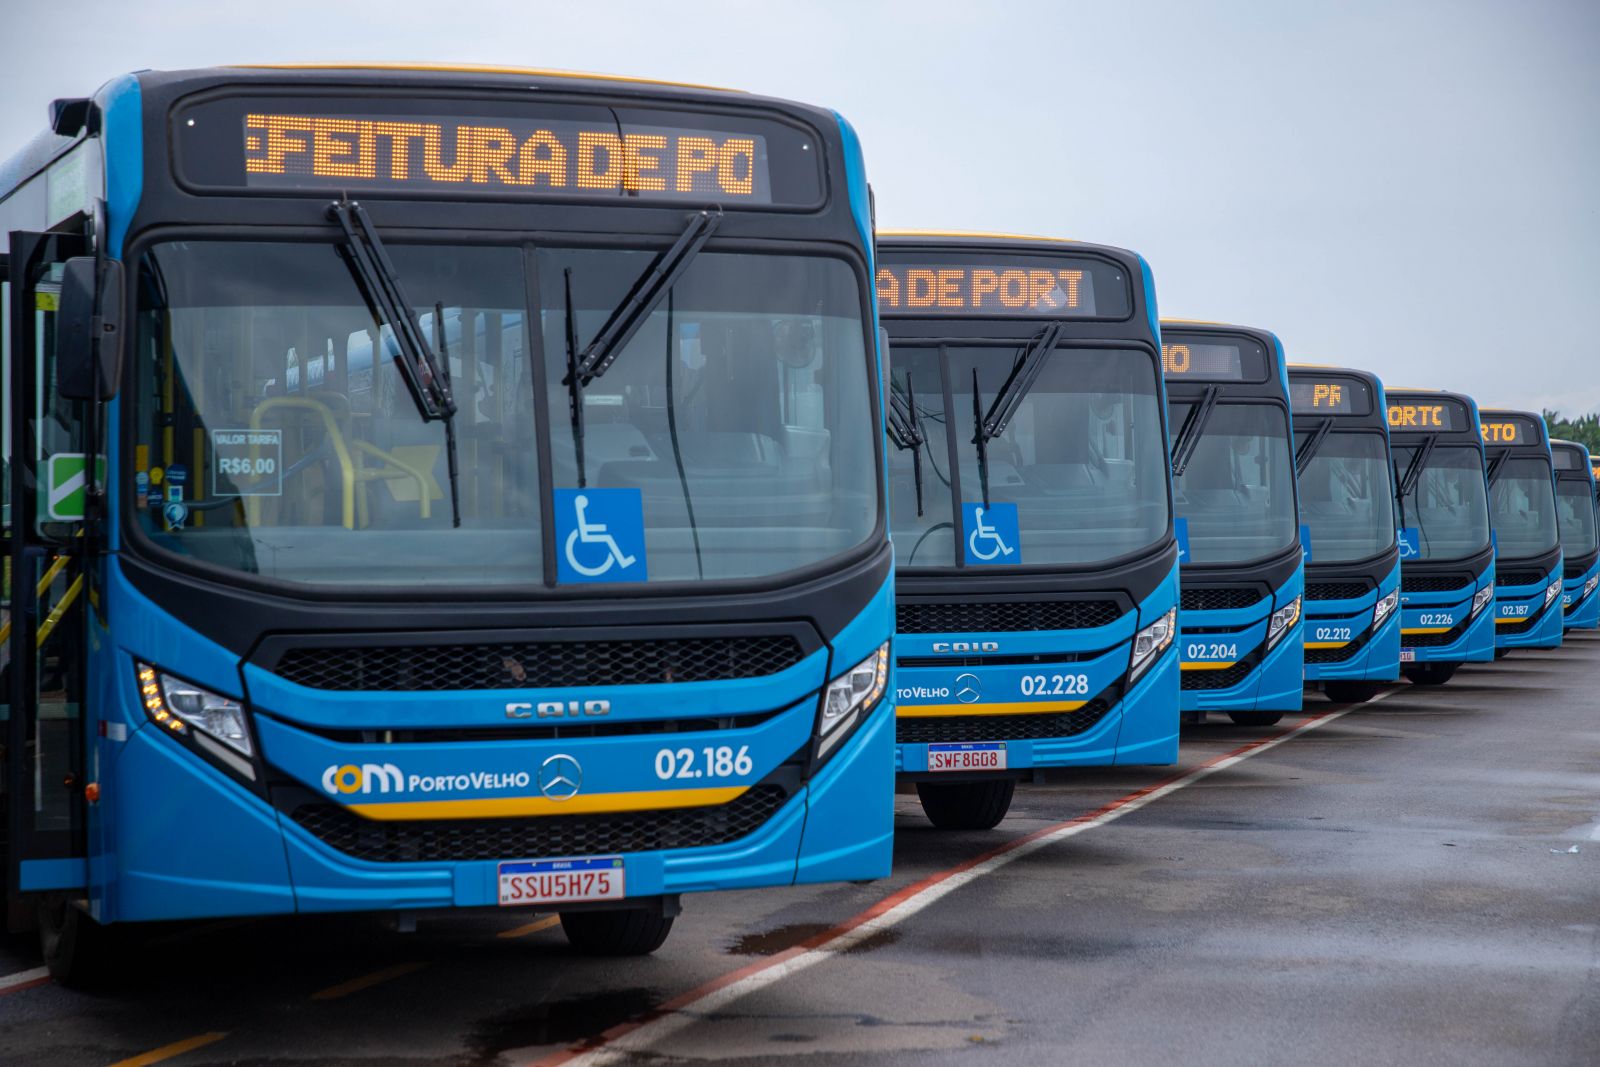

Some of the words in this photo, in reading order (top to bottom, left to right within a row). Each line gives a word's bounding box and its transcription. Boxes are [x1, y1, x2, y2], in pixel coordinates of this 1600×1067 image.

[577, 131, 667, 191] DE
[907, 269, 964, 307] DE
[971, 269, 1082, 307] PORT
[219, 458, 275, 477] R$6,00
[1420, 614, 1453, 625] 02.226
[1502, 606, 1528, 615] 02.187
[1316, 628, 1351, 640] 02.212
[1187, 644, 1237, 659] 02.204
[1020, 674, 1089, 696] 02.228
[655, 746, 752, 780] 02.186
[935, 752, 998, 769] SWF8G08
[511, 872, 610, 900] SSU5H75
